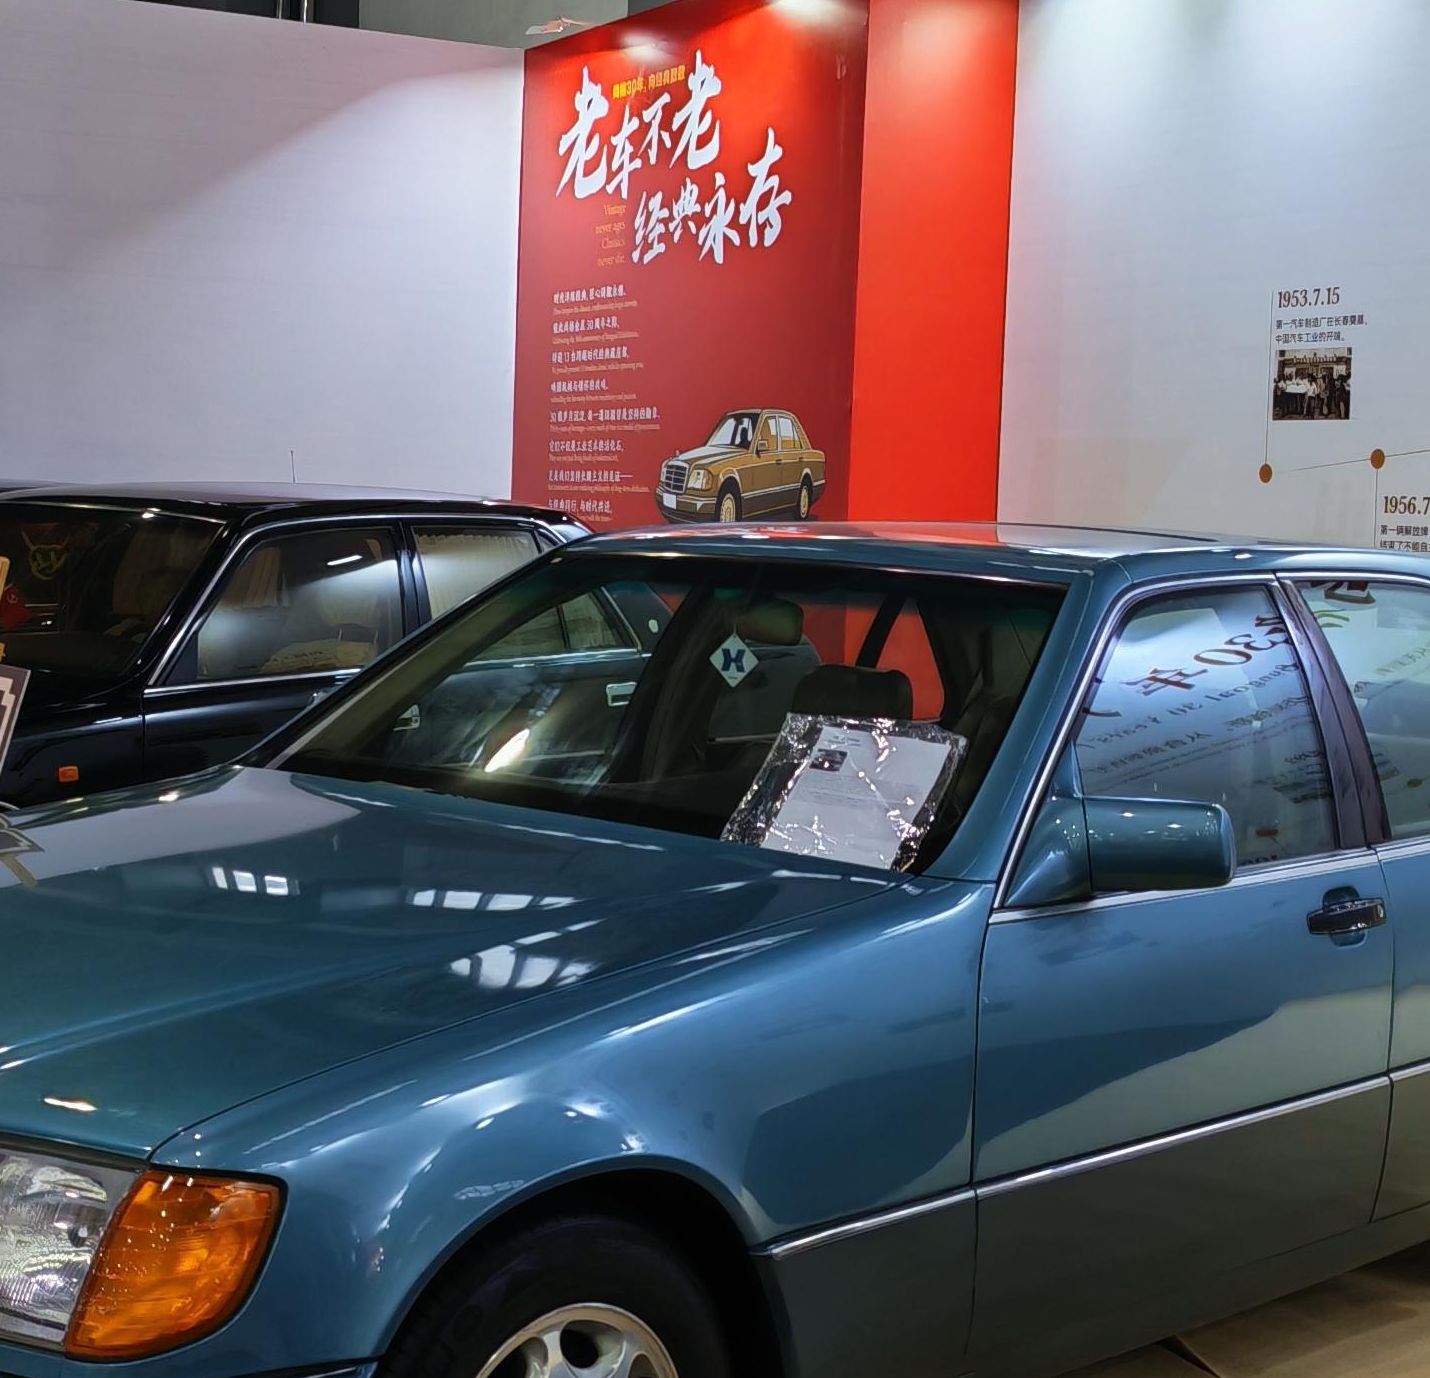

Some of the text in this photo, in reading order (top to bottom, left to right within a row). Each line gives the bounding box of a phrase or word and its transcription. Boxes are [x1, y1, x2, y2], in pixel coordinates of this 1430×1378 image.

[555, 48, 722, 200] 老车不老
[630, 125, 793, 264] 经典永存
[1277, 286, 1341, 309] 1953.7.15
